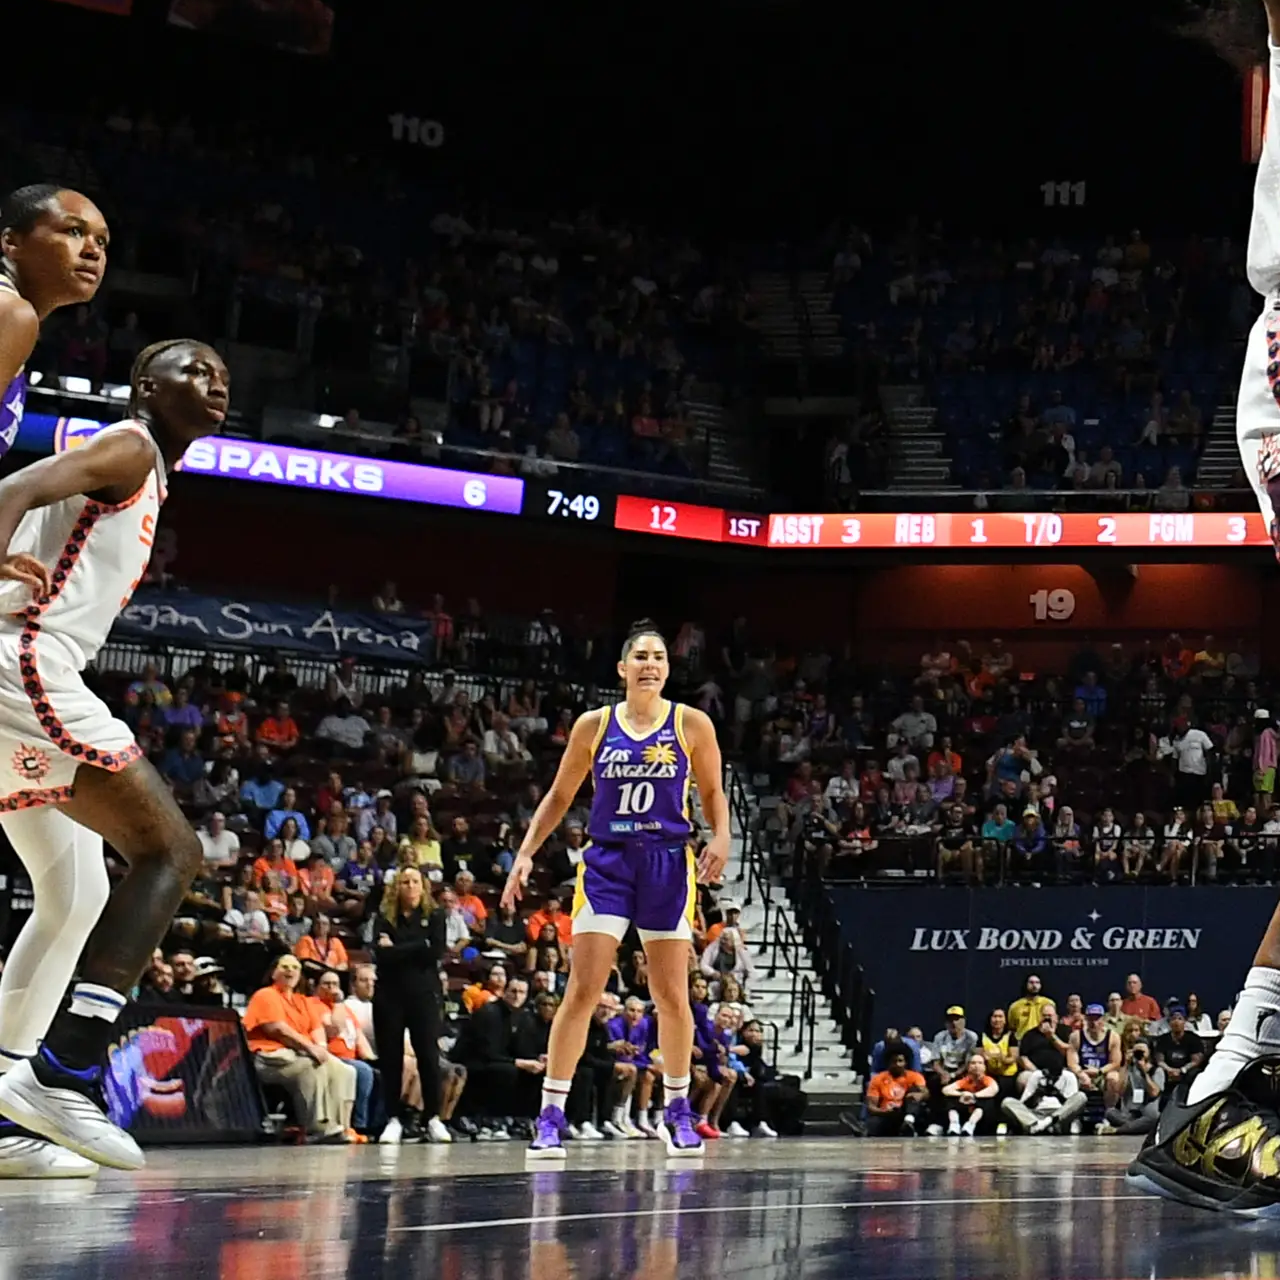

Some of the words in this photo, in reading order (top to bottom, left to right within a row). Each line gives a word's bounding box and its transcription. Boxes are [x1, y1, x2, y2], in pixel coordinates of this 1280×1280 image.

[388, 111, 445, 148] 110
[1040, 179, 1088, 208] 111
[183, 440, 384, 493] SPARKS
[463, 479, 487, 507] 6
[546, 489, 600, 521] 7:49
[649, 504, 677, 531] 12
[729, 517, 761, 538] 1ST
[770, 516, 824, 544] ASST
[841, 519, 861, 543] 3
[895, 515, 936, 543] REB
[970, 519, 987, 543] 1
[1023, 514, 1062, 546] T/O
[1097, 517, 1117, 542] 2
[1149, 514, 1194, 542] FGM
[1226, 516, 1247, 542] 3
[1029, 589, 1075, 620] 19
[115, 604, 209, 634] egan
[217, 603, 294, 639] Sun
[303, 610, 421, 651] Arena
[615, 781, 655, 815] 10
[611, 823, 631, 832] UCLA
[1070, 926, 1096, 951] &
